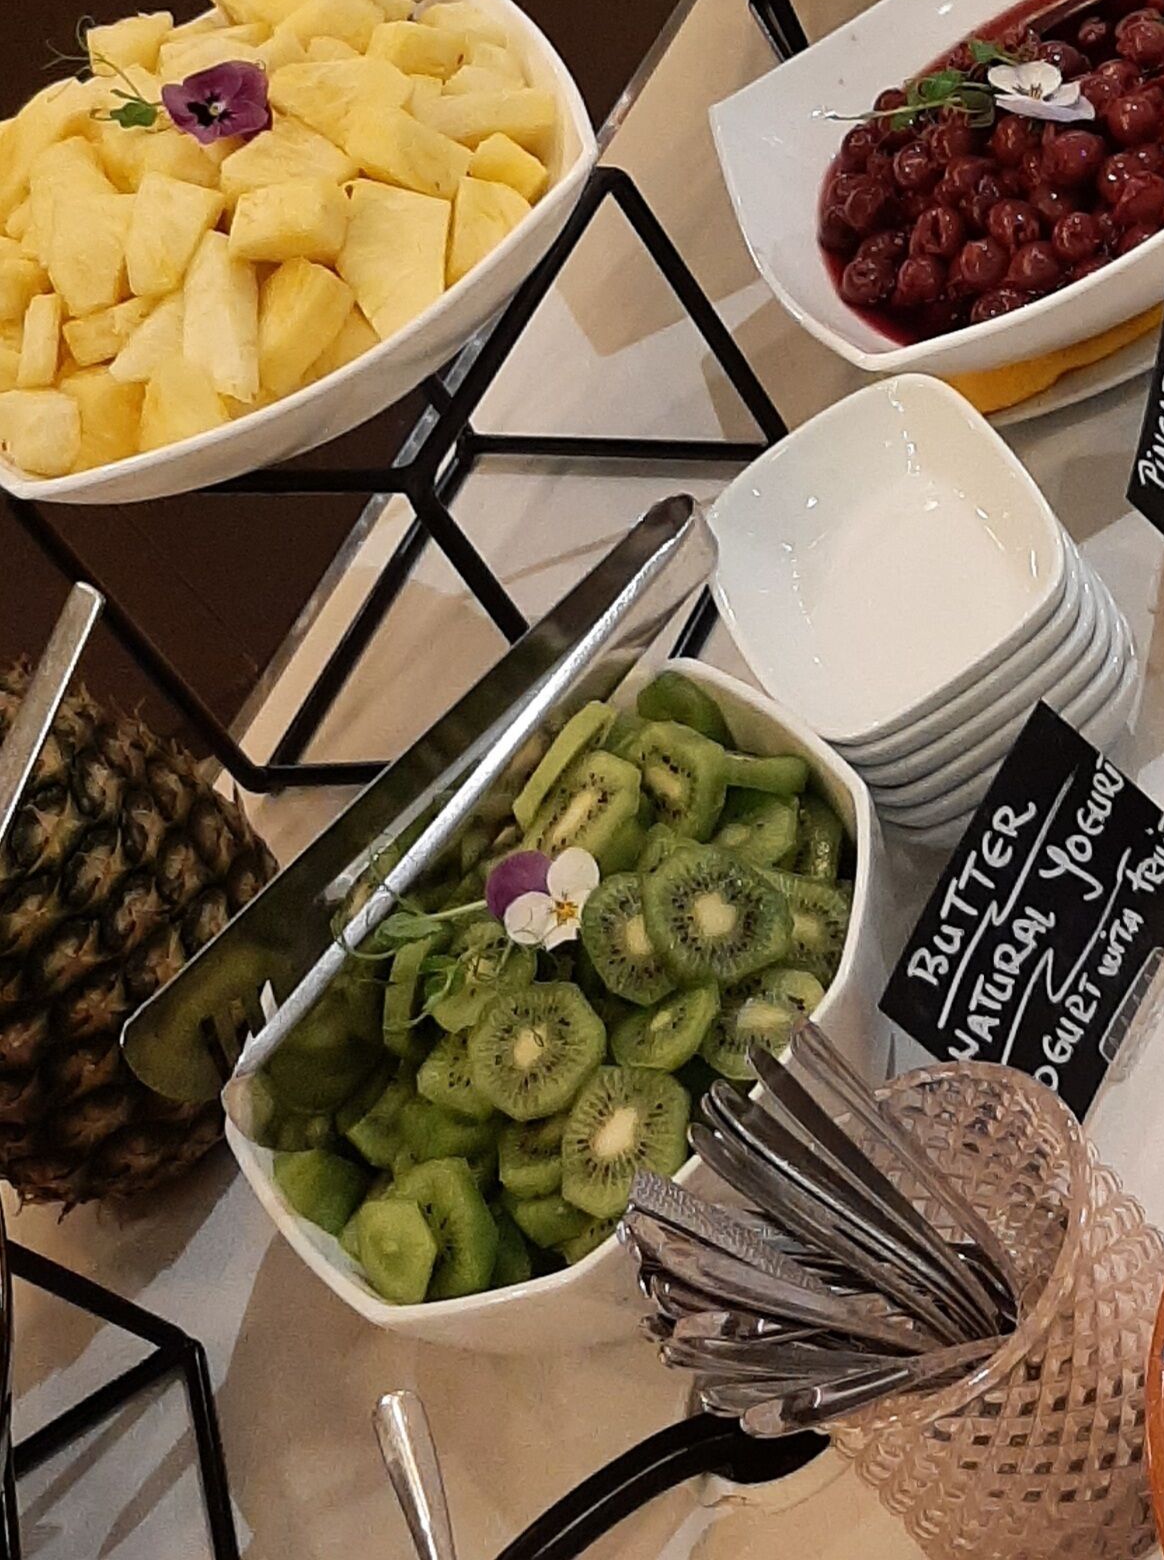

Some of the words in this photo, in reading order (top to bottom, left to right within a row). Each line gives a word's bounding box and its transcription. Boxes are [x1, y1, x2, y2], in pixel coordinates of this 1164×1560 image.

[907, 801, 1037, 987] BUTTER
[946, 905, 1056, 1060] NATURAL
[1037, 755, 1125, 901] YOGURT
[1035, 980, 1103, 1090] OGURT
